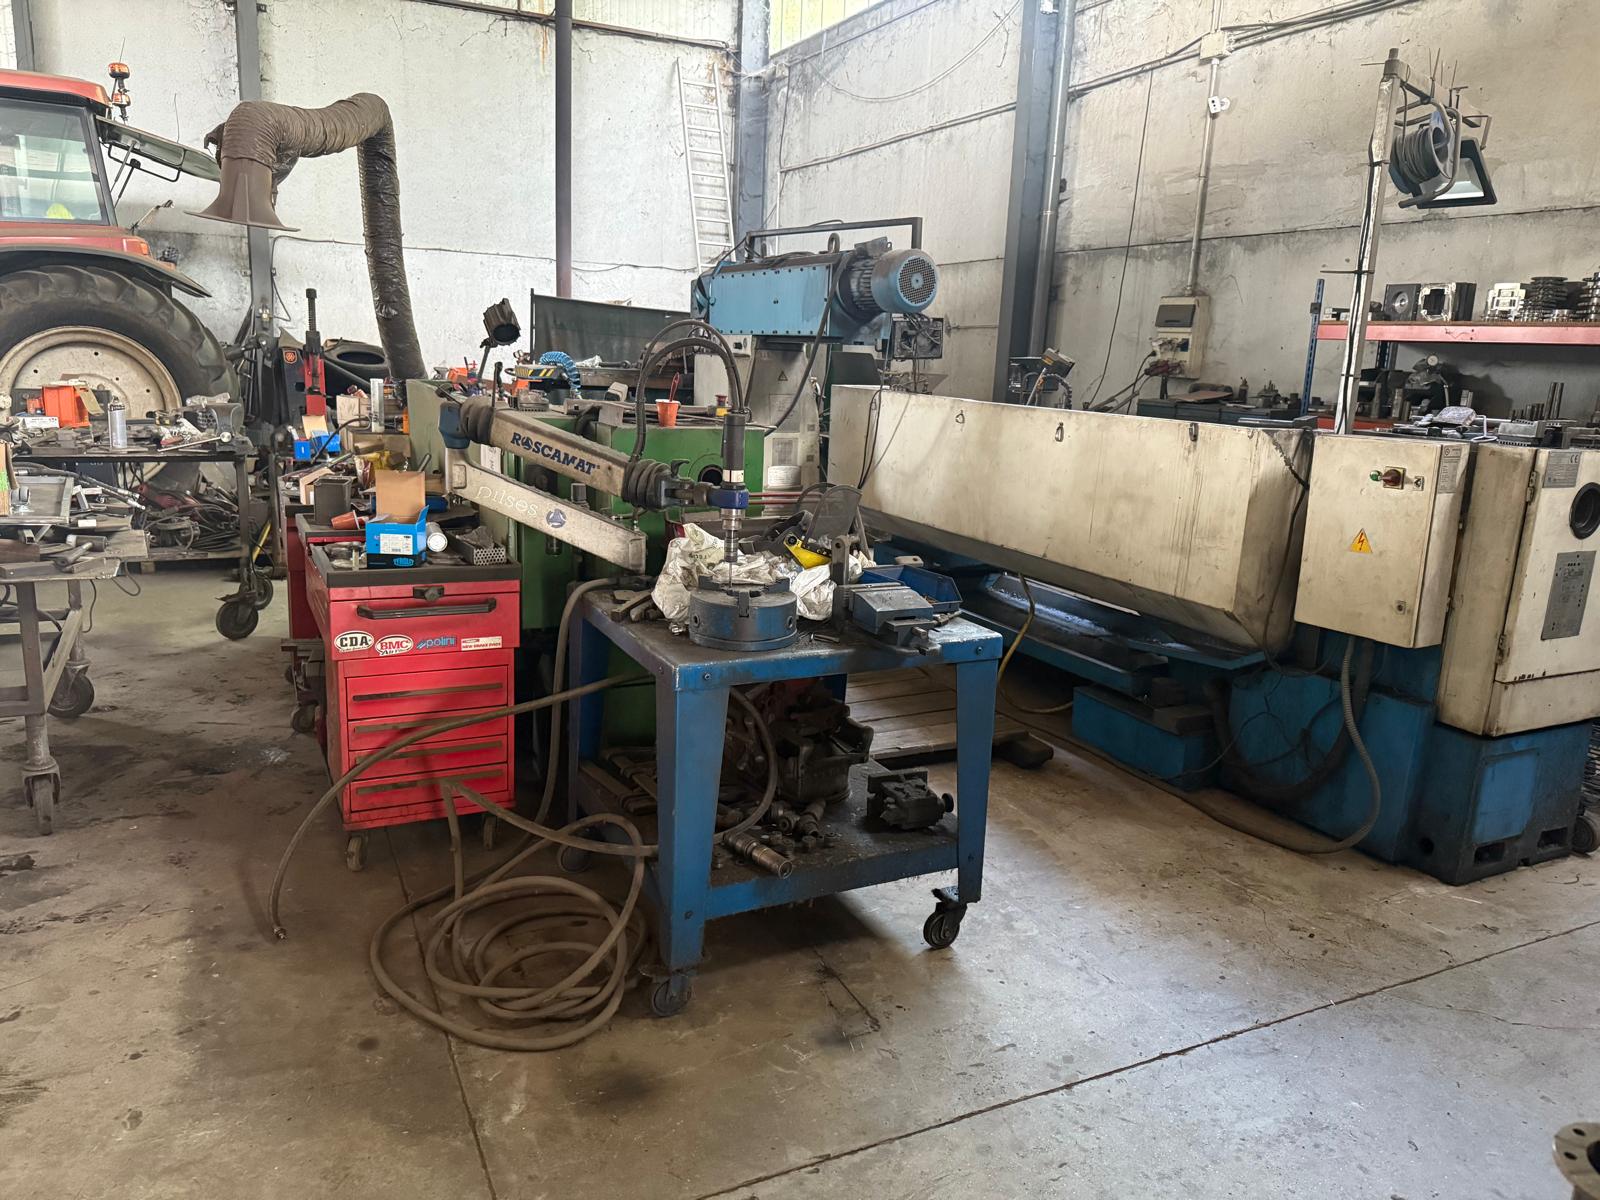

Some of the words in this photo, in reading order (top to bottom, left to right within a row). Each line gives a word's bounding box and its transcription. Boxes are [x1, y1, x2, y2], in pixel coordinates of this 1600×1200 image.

[510, 432, 597, 475] ROSCAMAT
[339, 636, 369, 648] CDA
[380, 640, 409, 650] BMC
